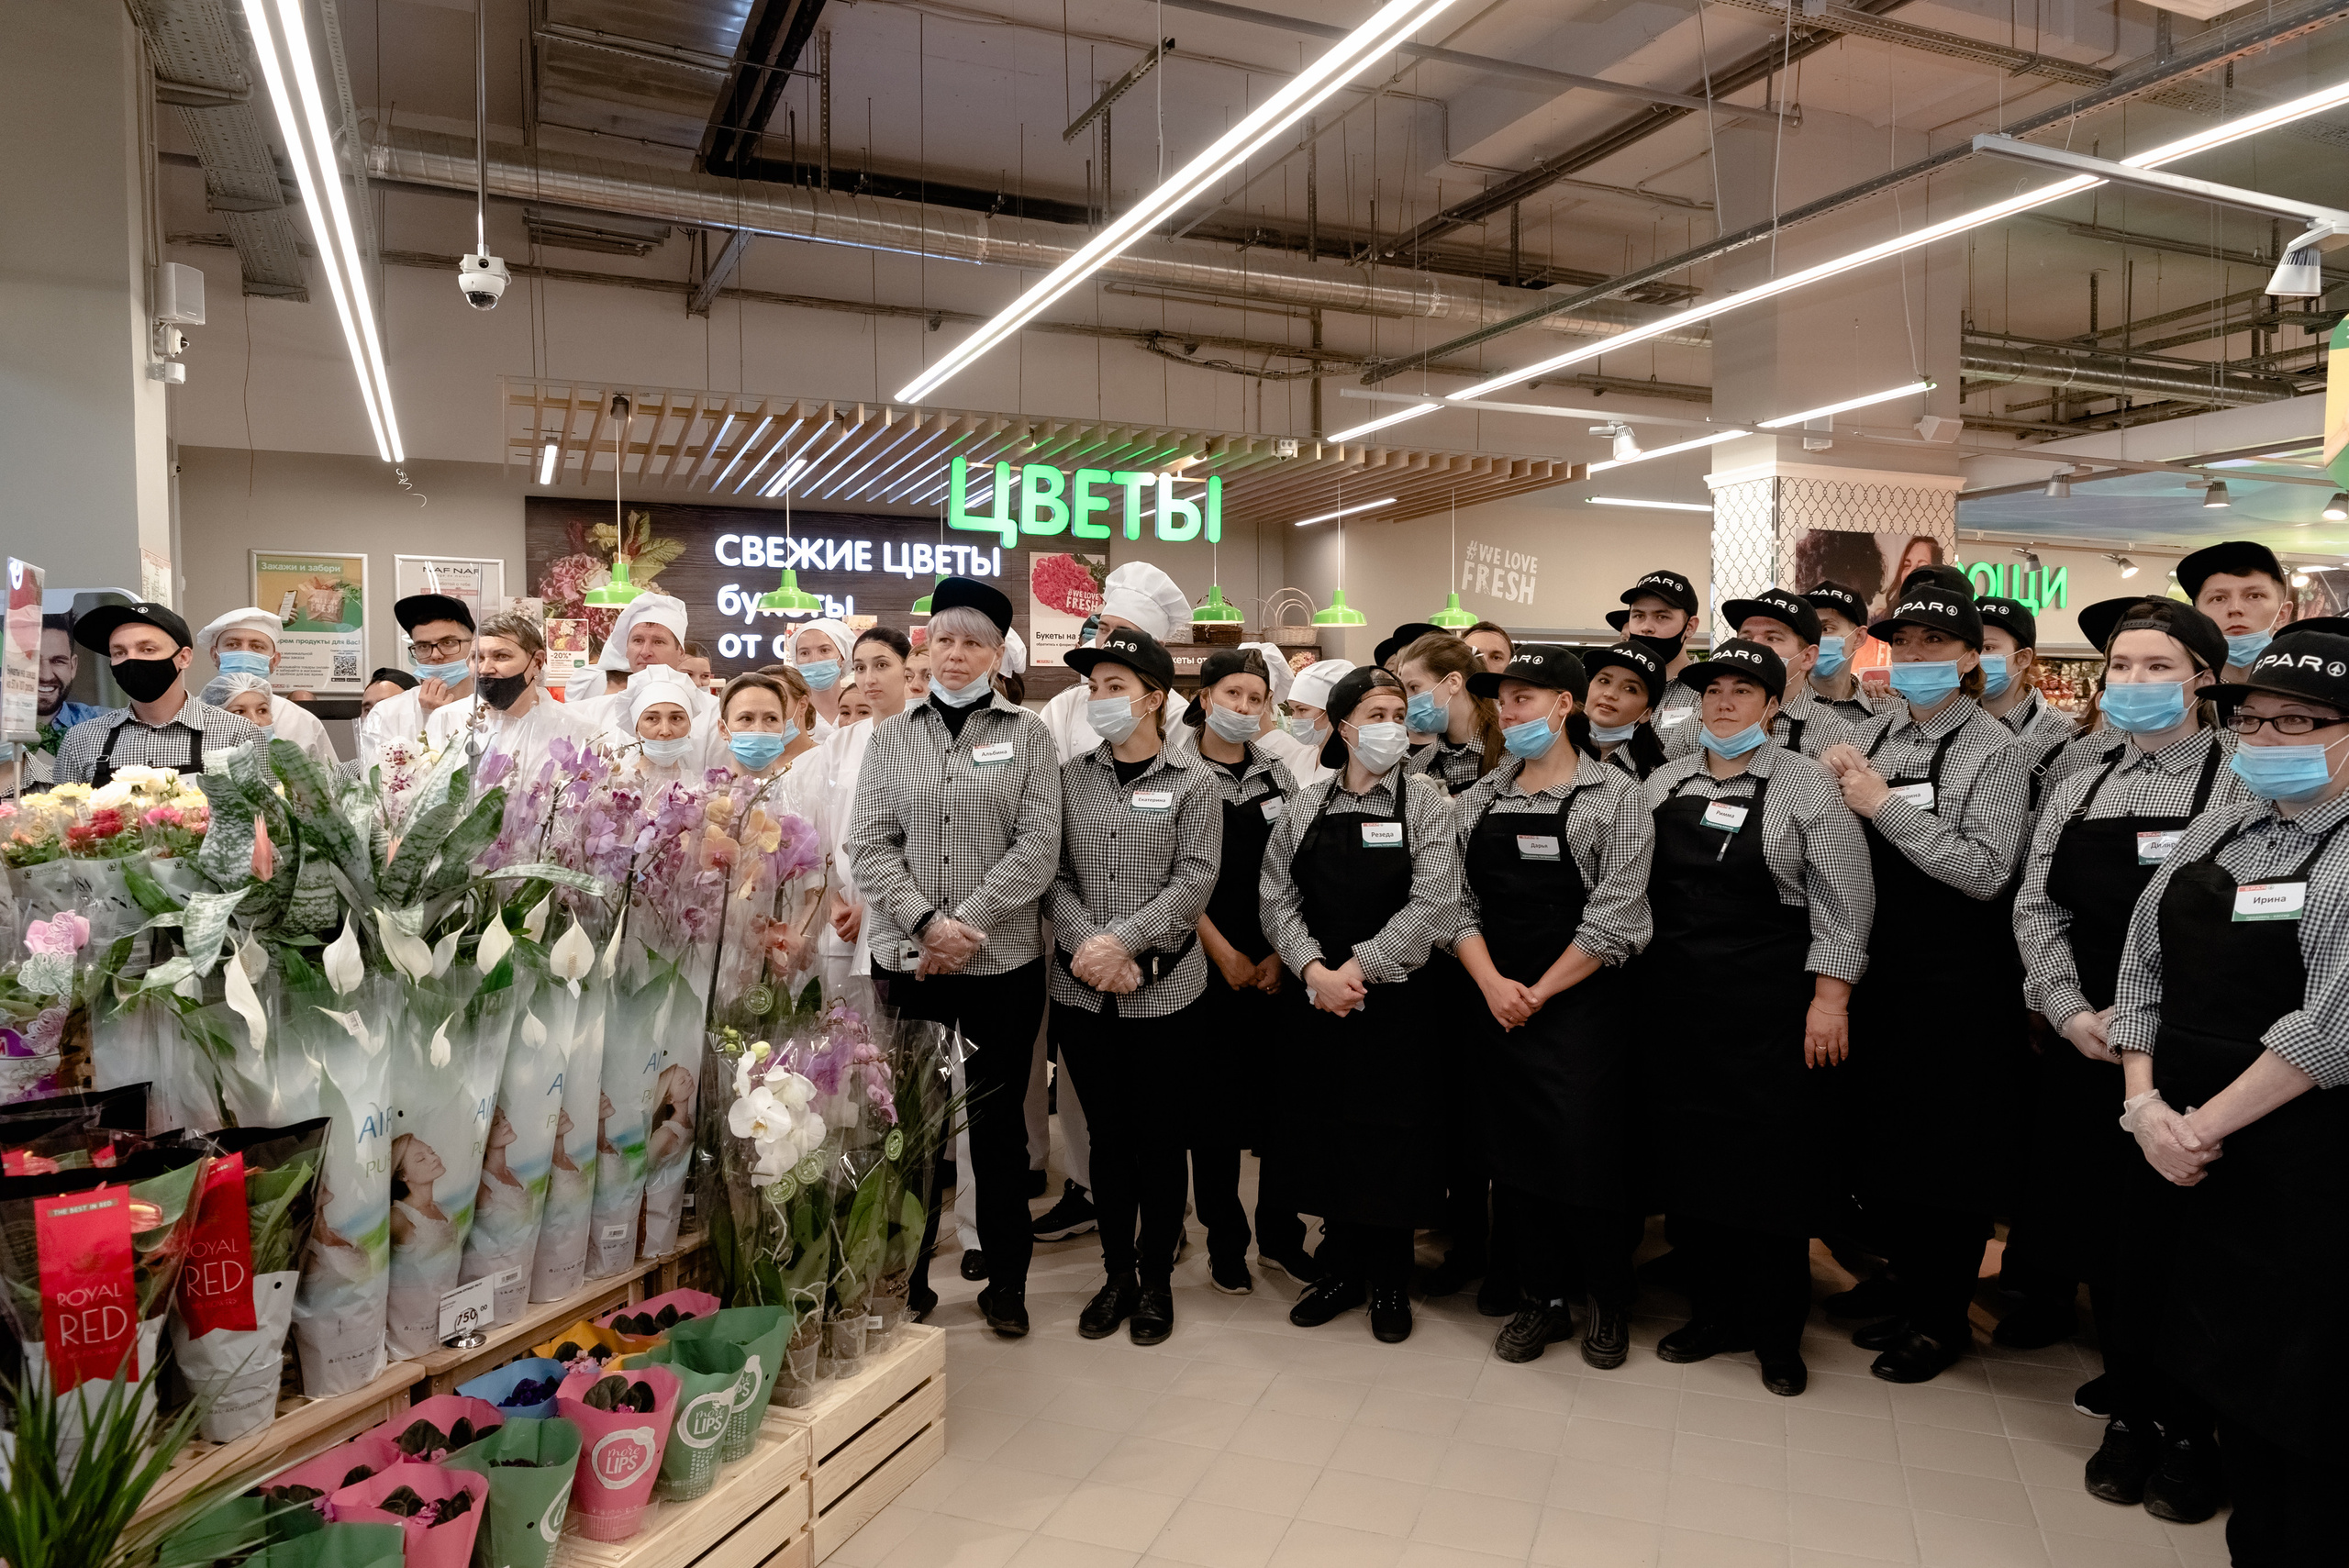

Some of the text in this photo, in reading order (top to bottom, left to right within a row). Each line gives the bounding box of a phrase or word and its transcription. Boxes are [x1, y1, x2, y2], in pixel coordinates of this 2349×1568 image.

[948, 456, 1222, 549] ЦВЕТЫ
[715, 534, 1001, 579] СВЕЖИЕ ЦВЕТЫ
[1466, 540, 1538, 574] #WE LOVE
[261, 562, 297, 571] Закажи
[308, 564, 340, 573] забери
[1461, 560, 1536, 605] FRESH
[1957, 561, 2067, 617] ОЩИ
[1085, 591, 1099, 600] LOVE
[1809, 589, 1842, 599] PAR
[717, 584, 854, 625] буты
[1065, 596, 1097, 612] FRESH
[1893, 601, 1943, 619] SPAR
[1036, 632, 1062, 640] Букеты
[718, 633, 763, 659] от
[1614, 649, 1647, 664] PAR
[2252, 653, 2323, 674] SPAR
[2254, 896, 2287, 905] Ирина
[53, 1208, 67, 1217] THE
[69, 1205, 87, 1215] BEST
[98, 1200, 113, 1208] RED
[184, 1260, 245, 1297] RED
[57, 1283, 122, 1307] ROYAL
[480, 1304, 488, 1312] 00
[60, 1306, 128, 1347] RED
[696, 1406, 725, 1419] more
[694, 1416, 723, 1435] LIPS
[607, 1444, 640, 1457] more
[606, 1455, 639, 1474] LIPS
